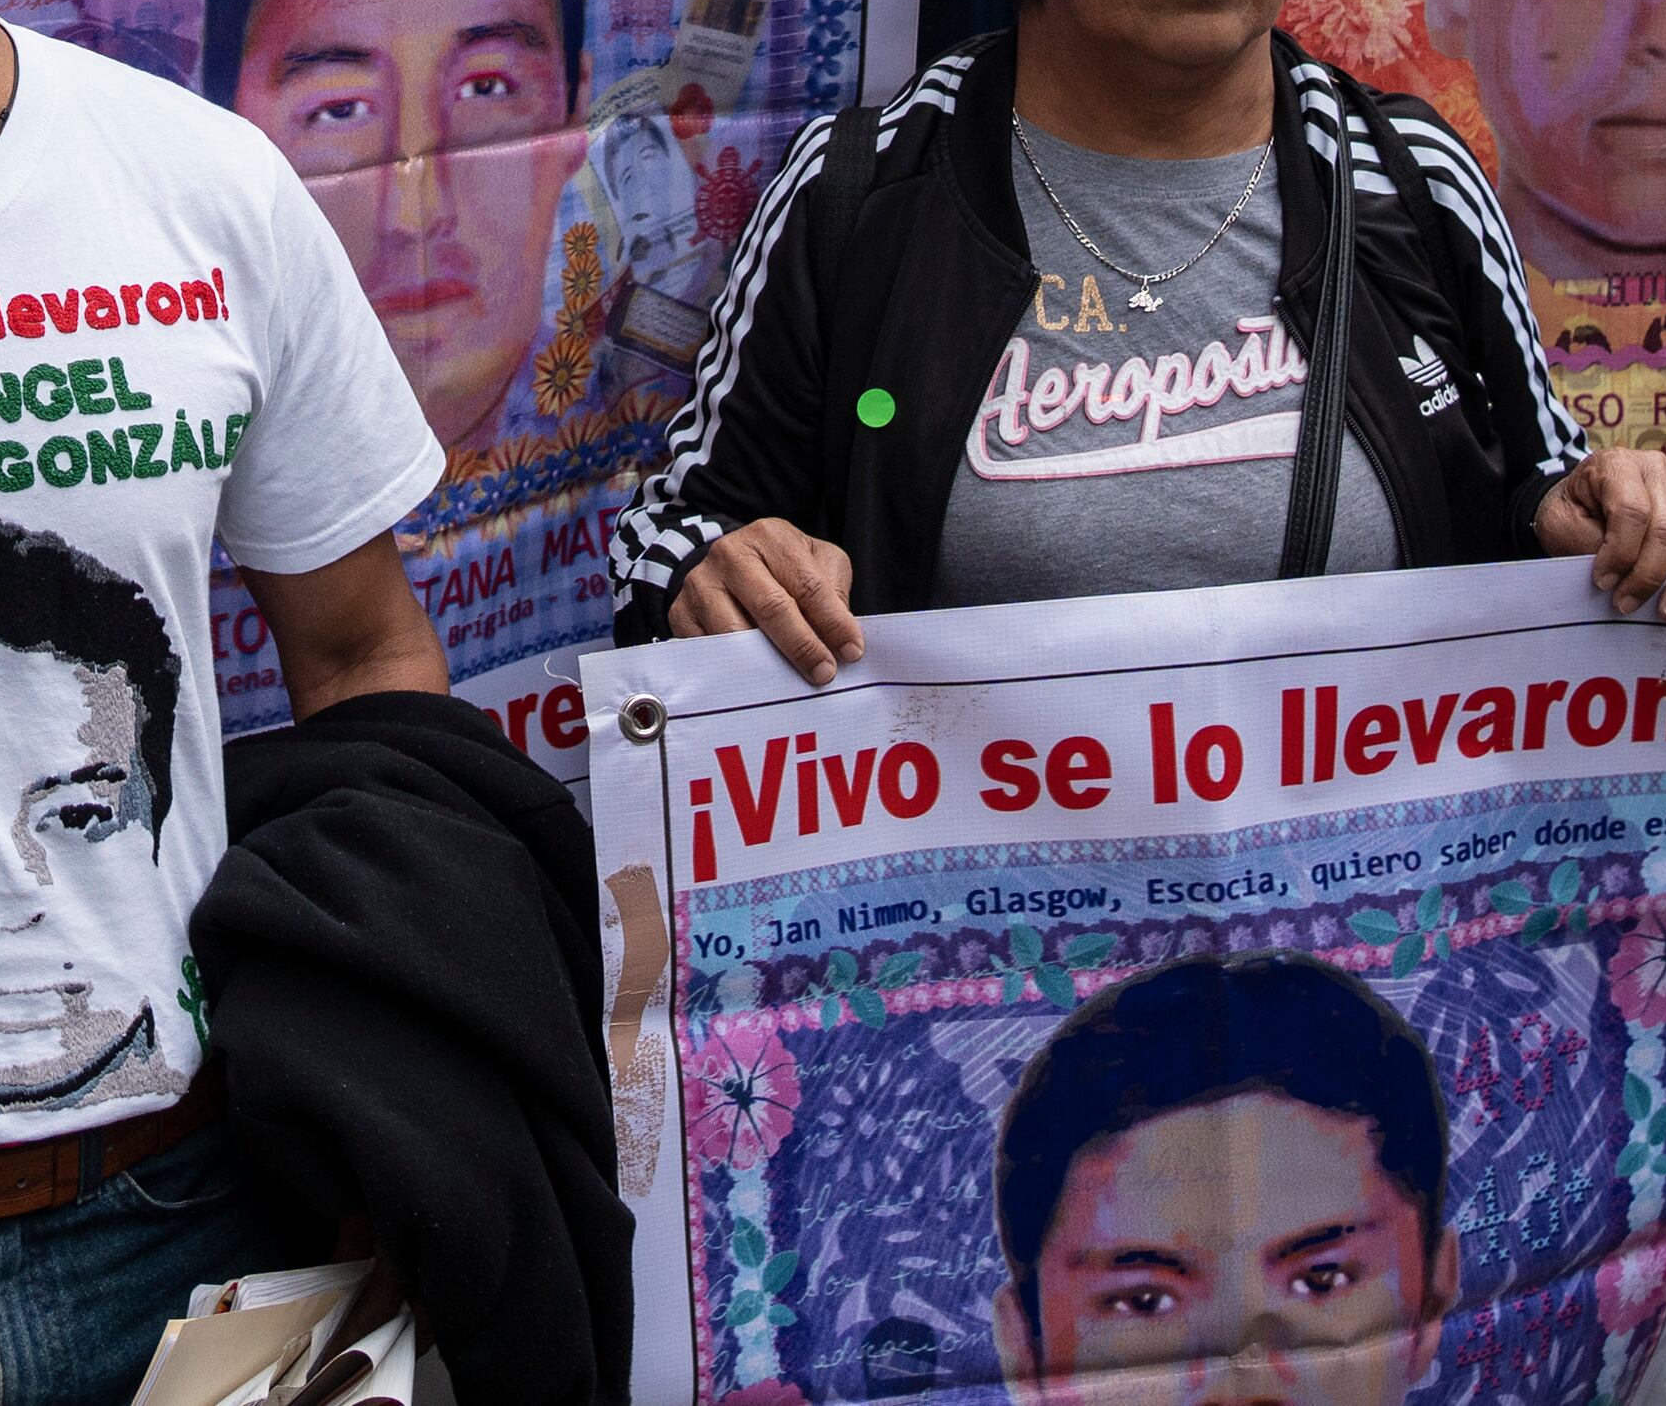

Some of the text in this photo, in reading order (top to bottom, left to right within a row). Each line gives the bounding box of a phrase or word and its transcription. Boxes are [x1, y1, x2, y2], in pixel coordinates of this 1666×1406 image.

[971, 314, 1310, 449] Aeropost
[1418, 380, 1461, 418] adida
[447, 595, 534, 649] Brígida
[689, 731, 941, 883] ¡Vivo
[979, 736, 1113, 813] se
[1148, 701, 1244, 802] lo
[693, 931, 747, 961] Yo,
[769, 915, 822, 947] Jan
[838, 898, 942, 933] Nimmo,
[965, 886, 1122, 918] Glasgow,
[1146, 870, 1289, 906] Escocia,
[1310, 849, 1422, 890] quiero
[1440, 825, 1517, 867] saber
[1534, 813, 1626, 847] dónde
